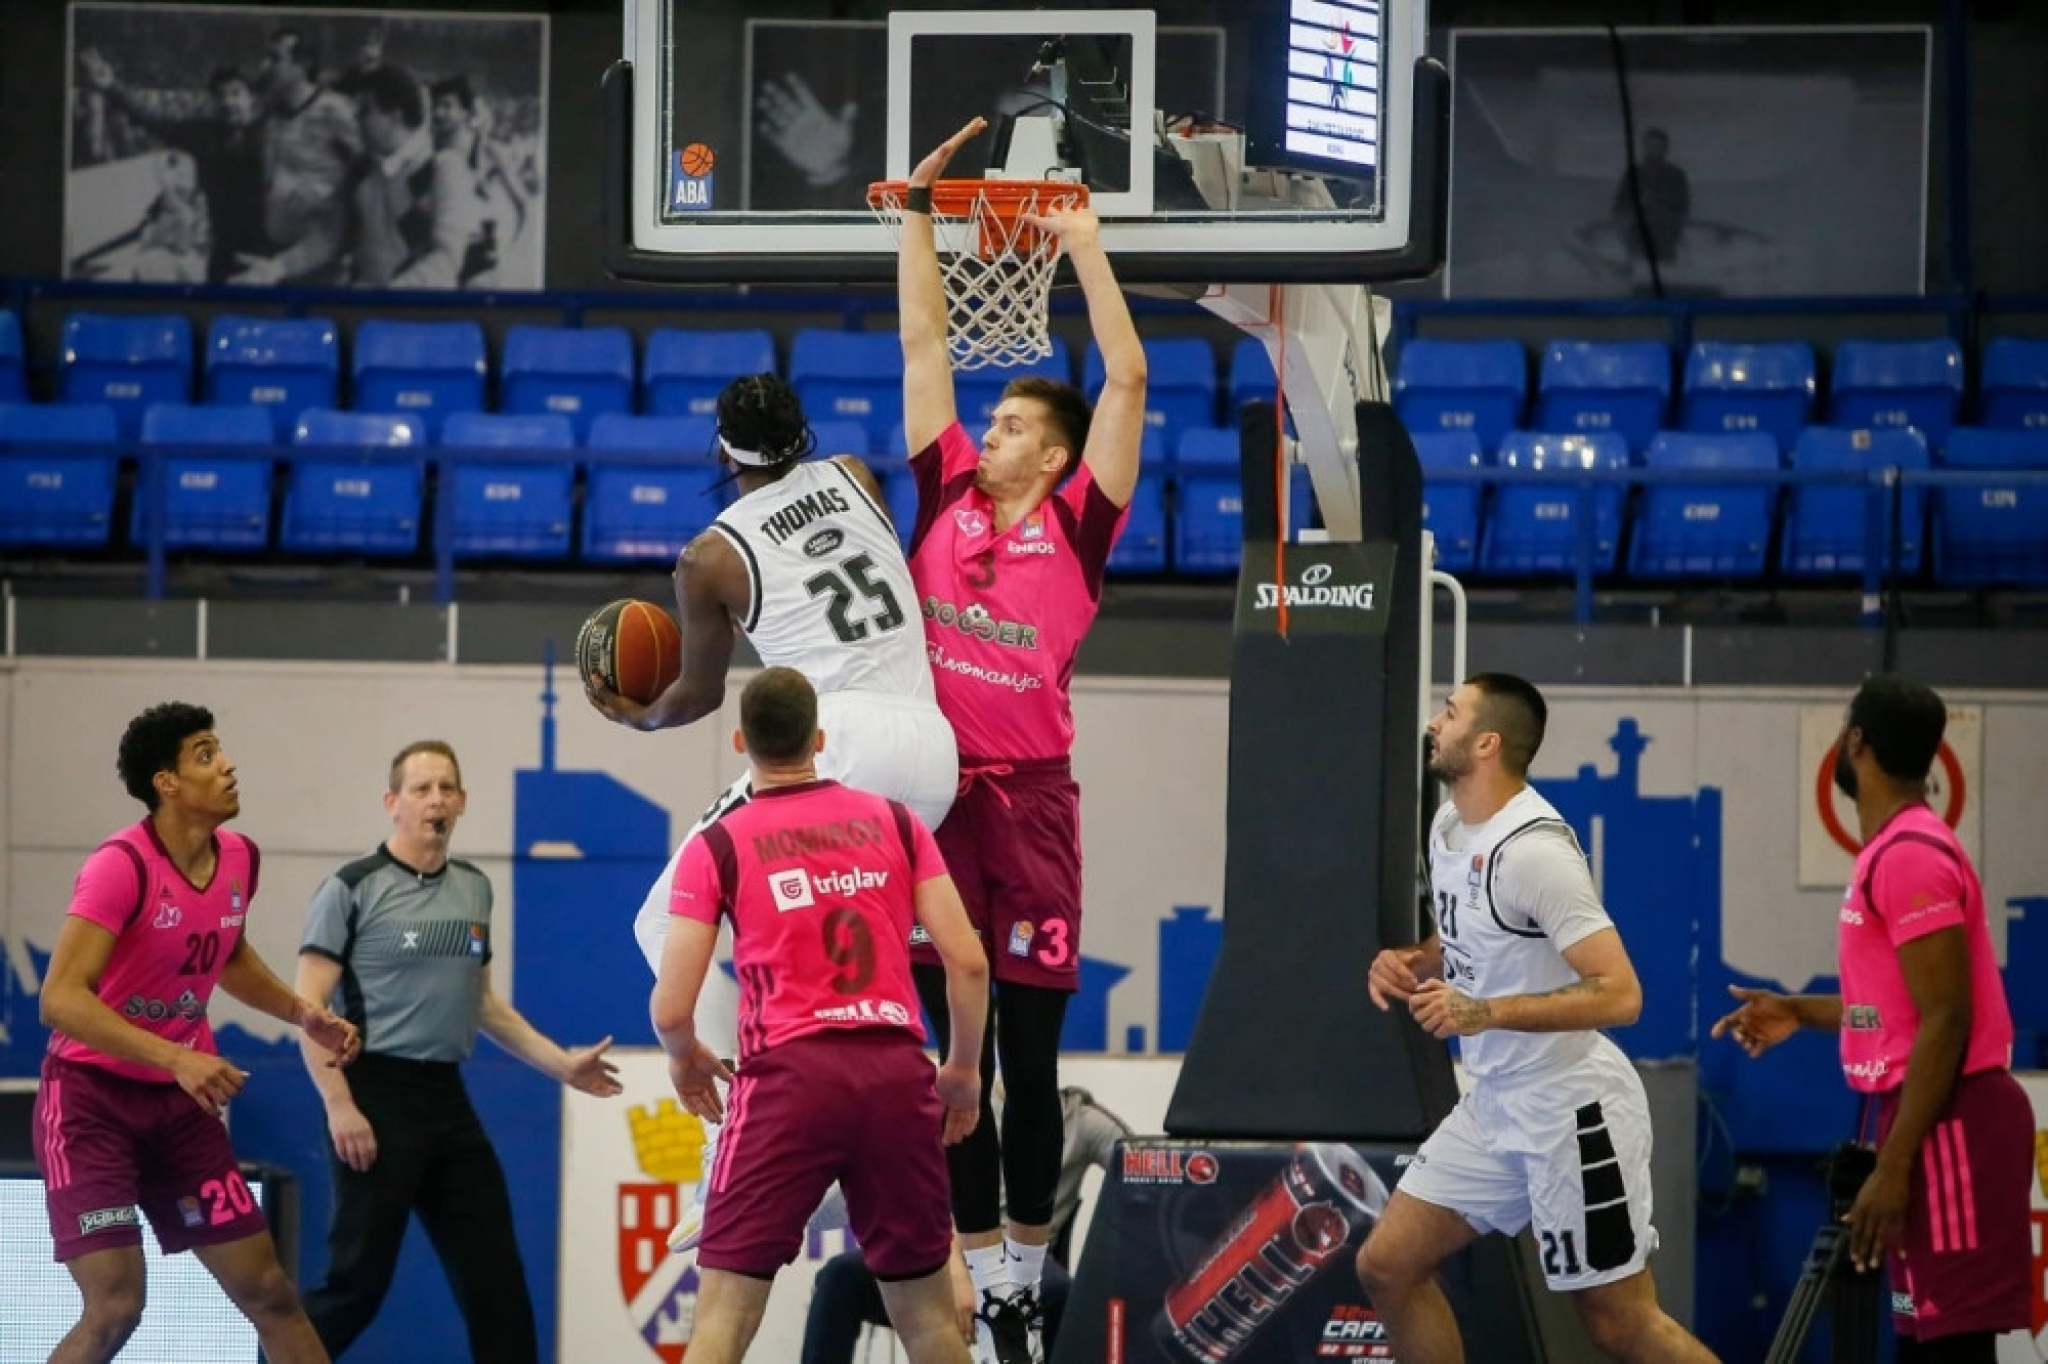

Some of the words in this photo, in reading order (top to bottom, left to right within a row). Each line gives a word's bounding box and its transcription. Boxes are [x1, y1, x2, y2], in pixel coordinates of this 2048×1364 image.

[675, 179, 708, 204] ABA
[760, 487, 850, 545] THOMAS
[966, 550, 997, 590] 3
[803, 551, 905, 643] 25
[1254, 583, 1374, 609] SPALDING
[812, 866, 888, 896] triglav
[1438, 889, 1458, 939] 21
[178, 930, 219, 975] 20
[822, 908, 876, 995] 9
[1038, 918, 1068, 966] 3
[1124, 1148, 1183, 1177] HELL
[201, 1170, 252, 1225] 20
[1541, 1229, 1582, 1276] 21
[1186, 1239, 1316, 1352] HELL
